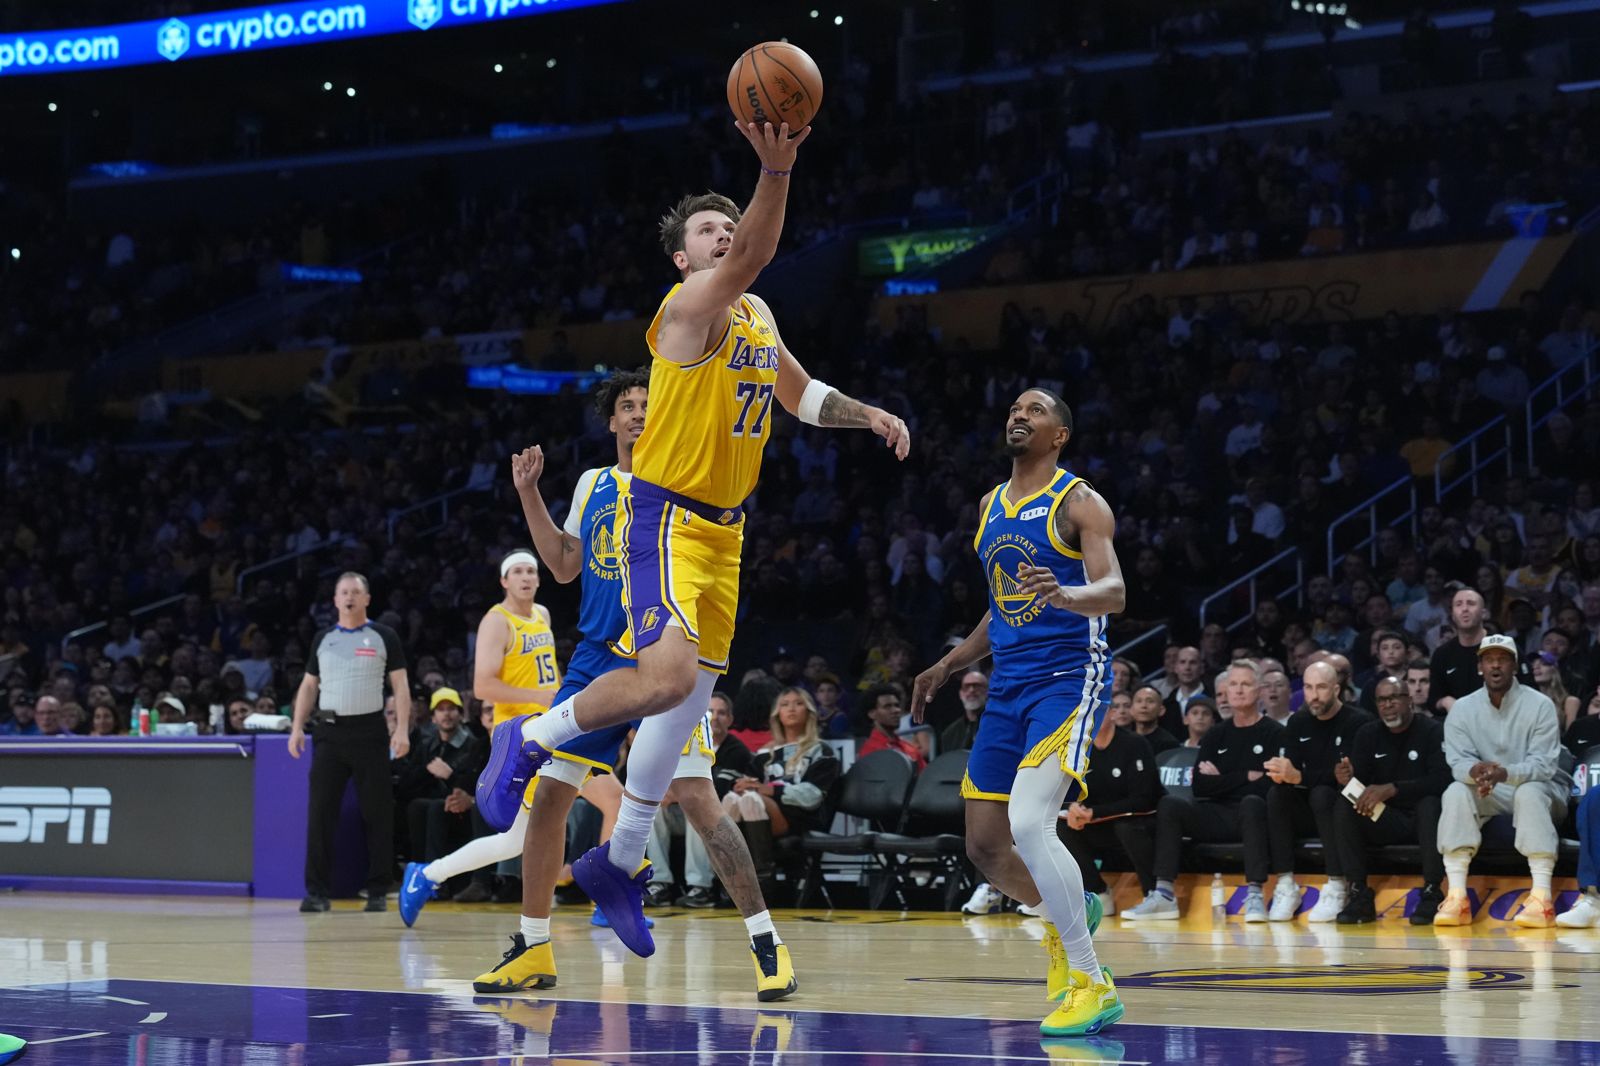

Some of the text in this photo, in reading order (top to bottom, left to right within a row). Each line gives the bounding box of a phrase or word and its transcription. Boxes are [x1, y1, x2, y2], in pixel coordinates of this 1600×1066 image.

[196, 4, 366, 49] crypto.com
[732, 381, 775, 438] 77
[591, 502, 616, 522] GOLDE
[984, 533, 1038, 558] GOLDEN STATE
[588, 558, 620, 581] WARRI
[535, 653, 556, 685] 15
[1160, 766, 1182, 786] THE
